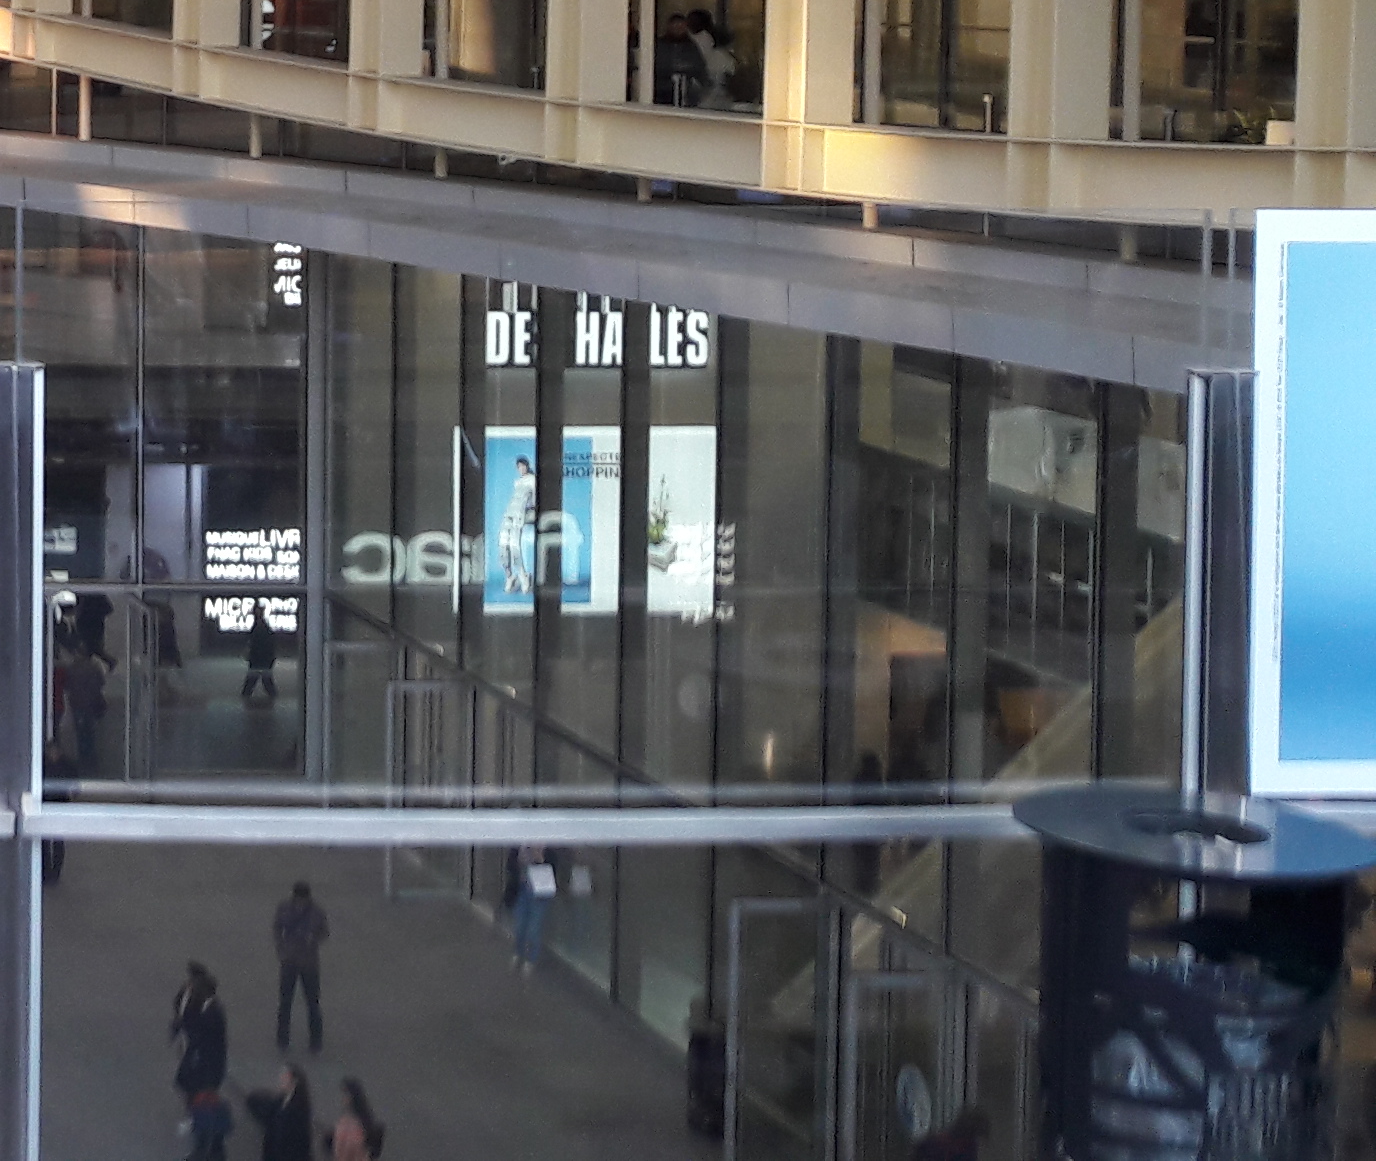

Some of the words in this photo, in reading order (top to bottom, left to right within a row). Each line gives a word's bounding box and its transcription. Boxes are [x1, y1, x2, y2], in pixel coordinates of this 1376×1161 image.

[485, 310, 539, 367] DE
[575, 309, 710, 367] HALES
[562, 466, 621, 478] HOPPIN
